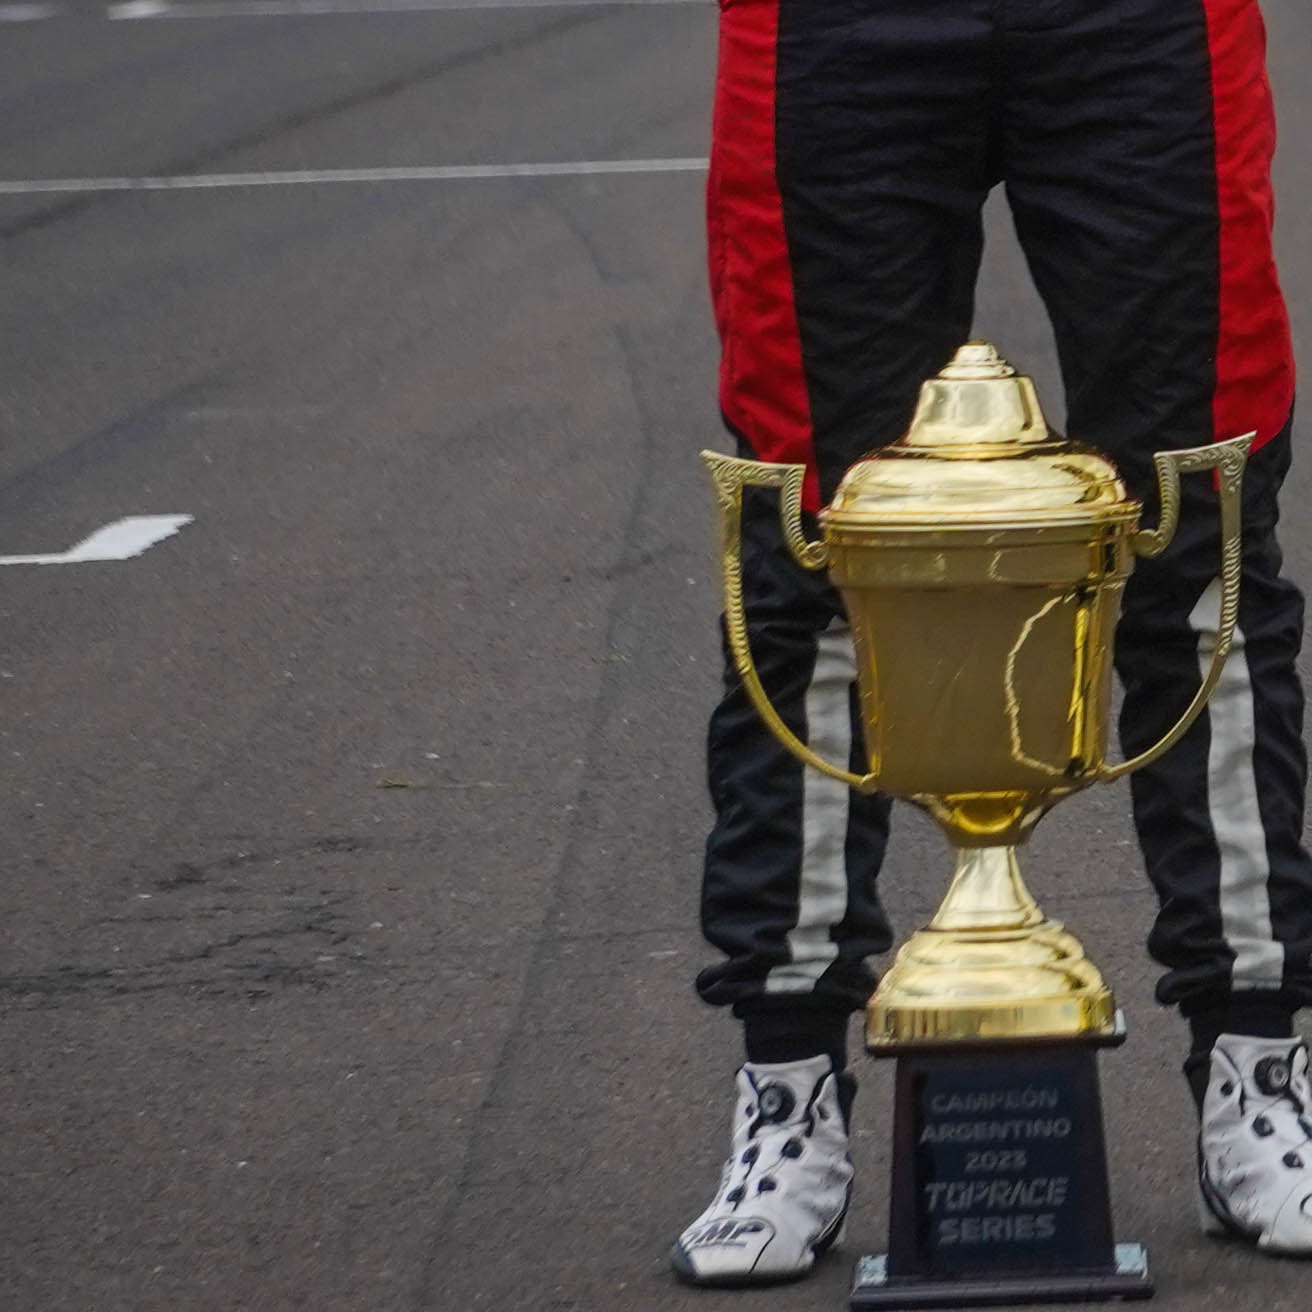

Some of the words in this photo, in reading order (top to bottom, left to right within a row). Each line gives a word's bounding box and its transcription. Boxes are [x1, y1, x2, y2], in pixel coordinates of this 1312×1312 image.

[920, 1118, 1072, 1143] ARGENTINO
[965, 1150, 1028, 1172] 2023
[925, 1176, 1069, 1211] TOPRACE
[937, 1213, 1056, 1243] SERIES
